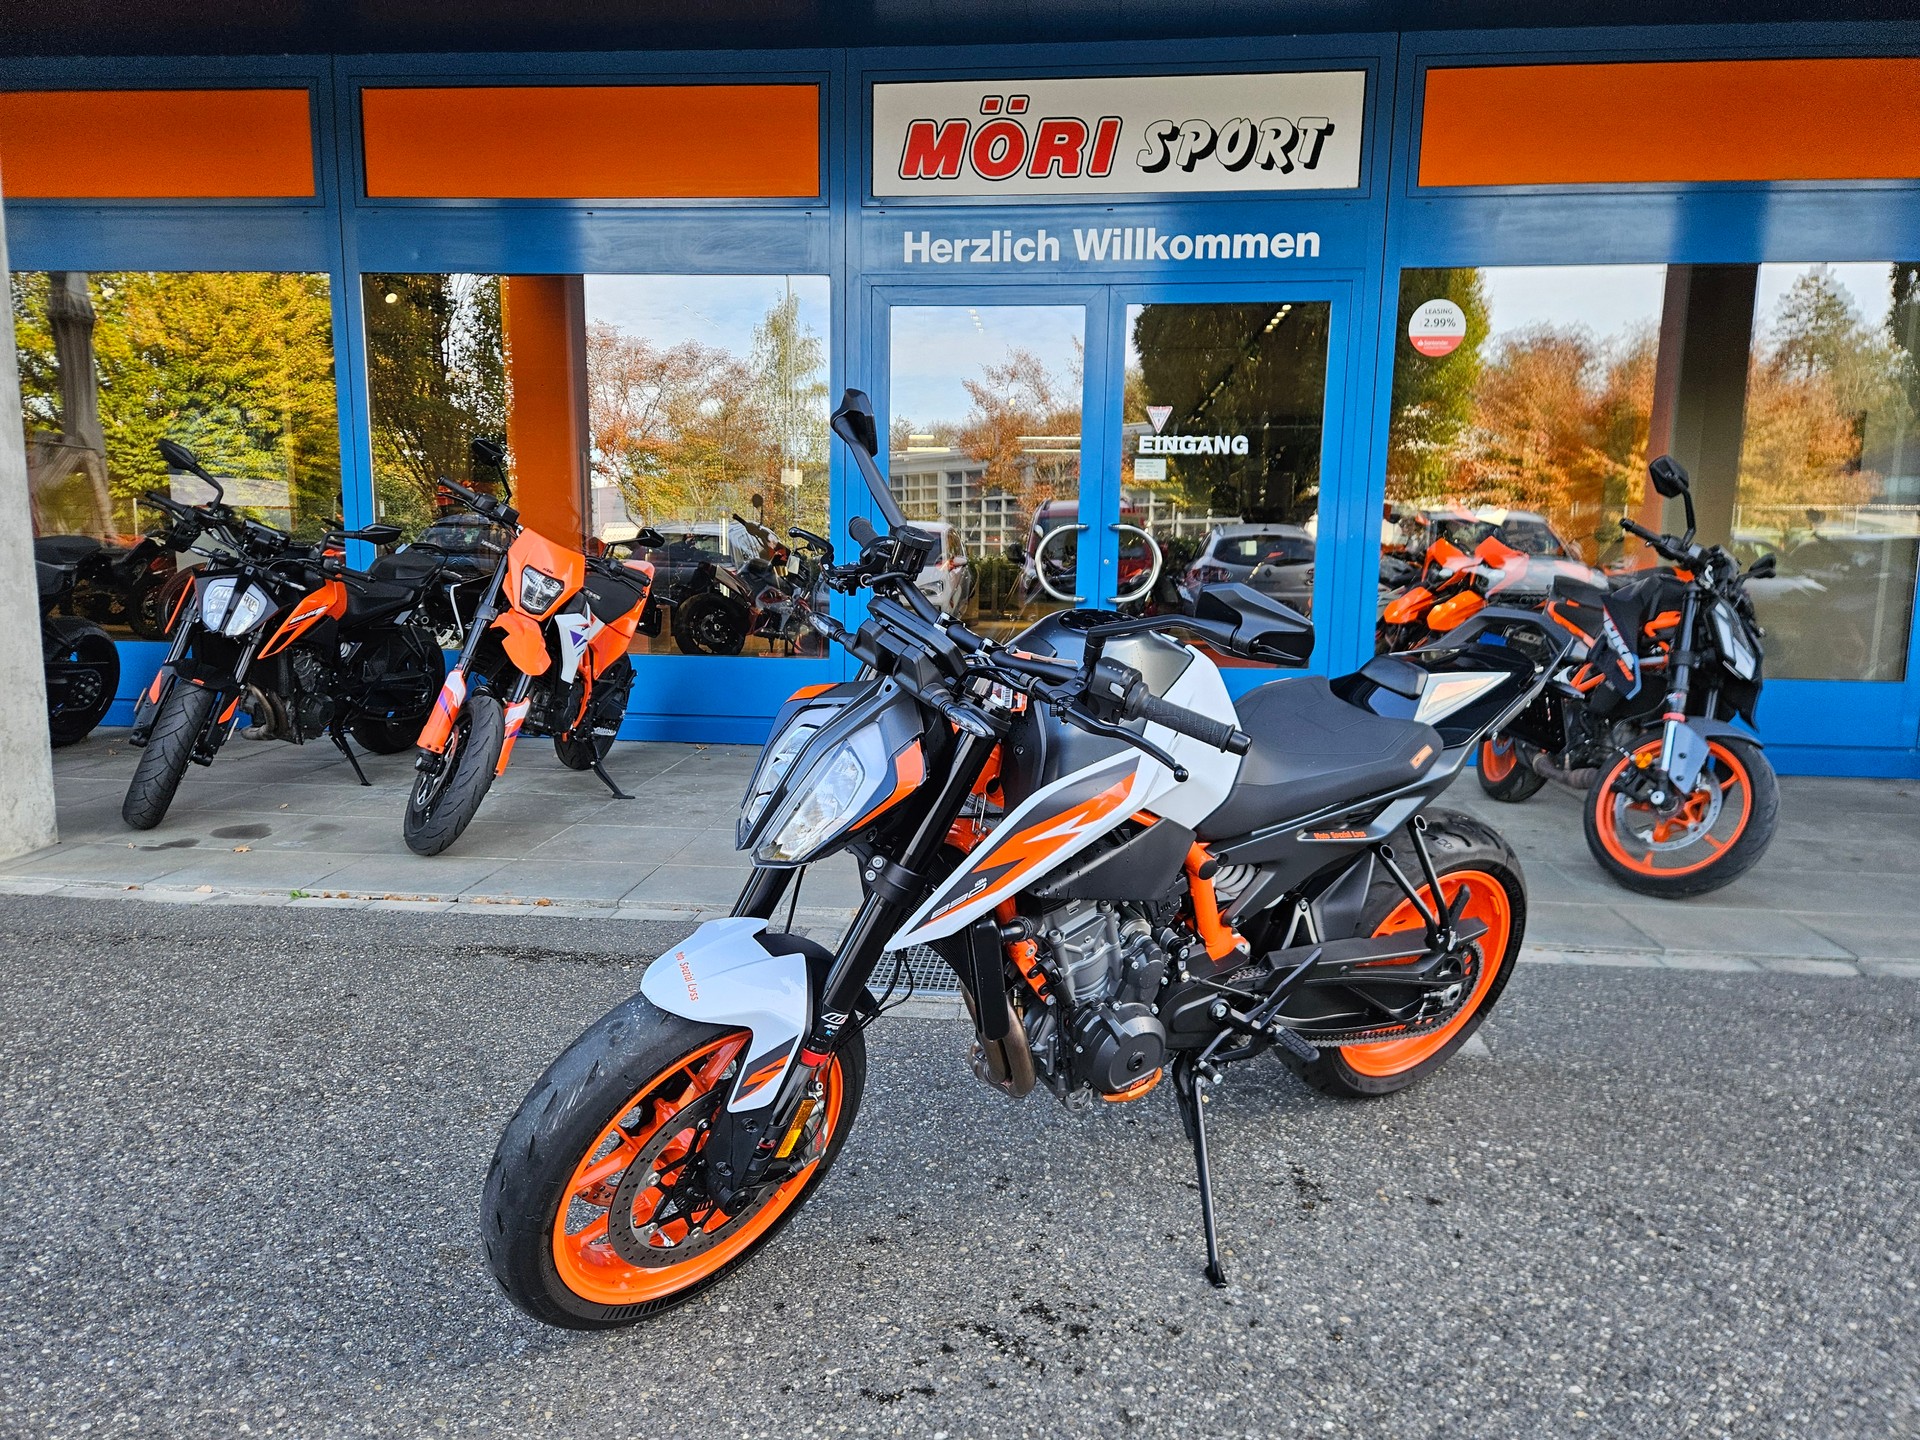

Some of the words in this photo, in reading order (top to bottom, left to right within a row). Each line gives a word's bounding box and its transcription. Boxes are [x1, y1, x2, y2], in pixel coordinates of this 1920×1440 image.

[899, 95, 1122, 180] MÖRI
[1136, 117, 1334, 174] SPORT
[904, 230, 1059, 263] Herzlich
[1074, 227, 1320, 262] Willkommen
[1424, 318, 1456, 327] 2.99%
[1139, 435, 1249, 454] EINGANG
[687, 983, 699, 1001] Lyss
